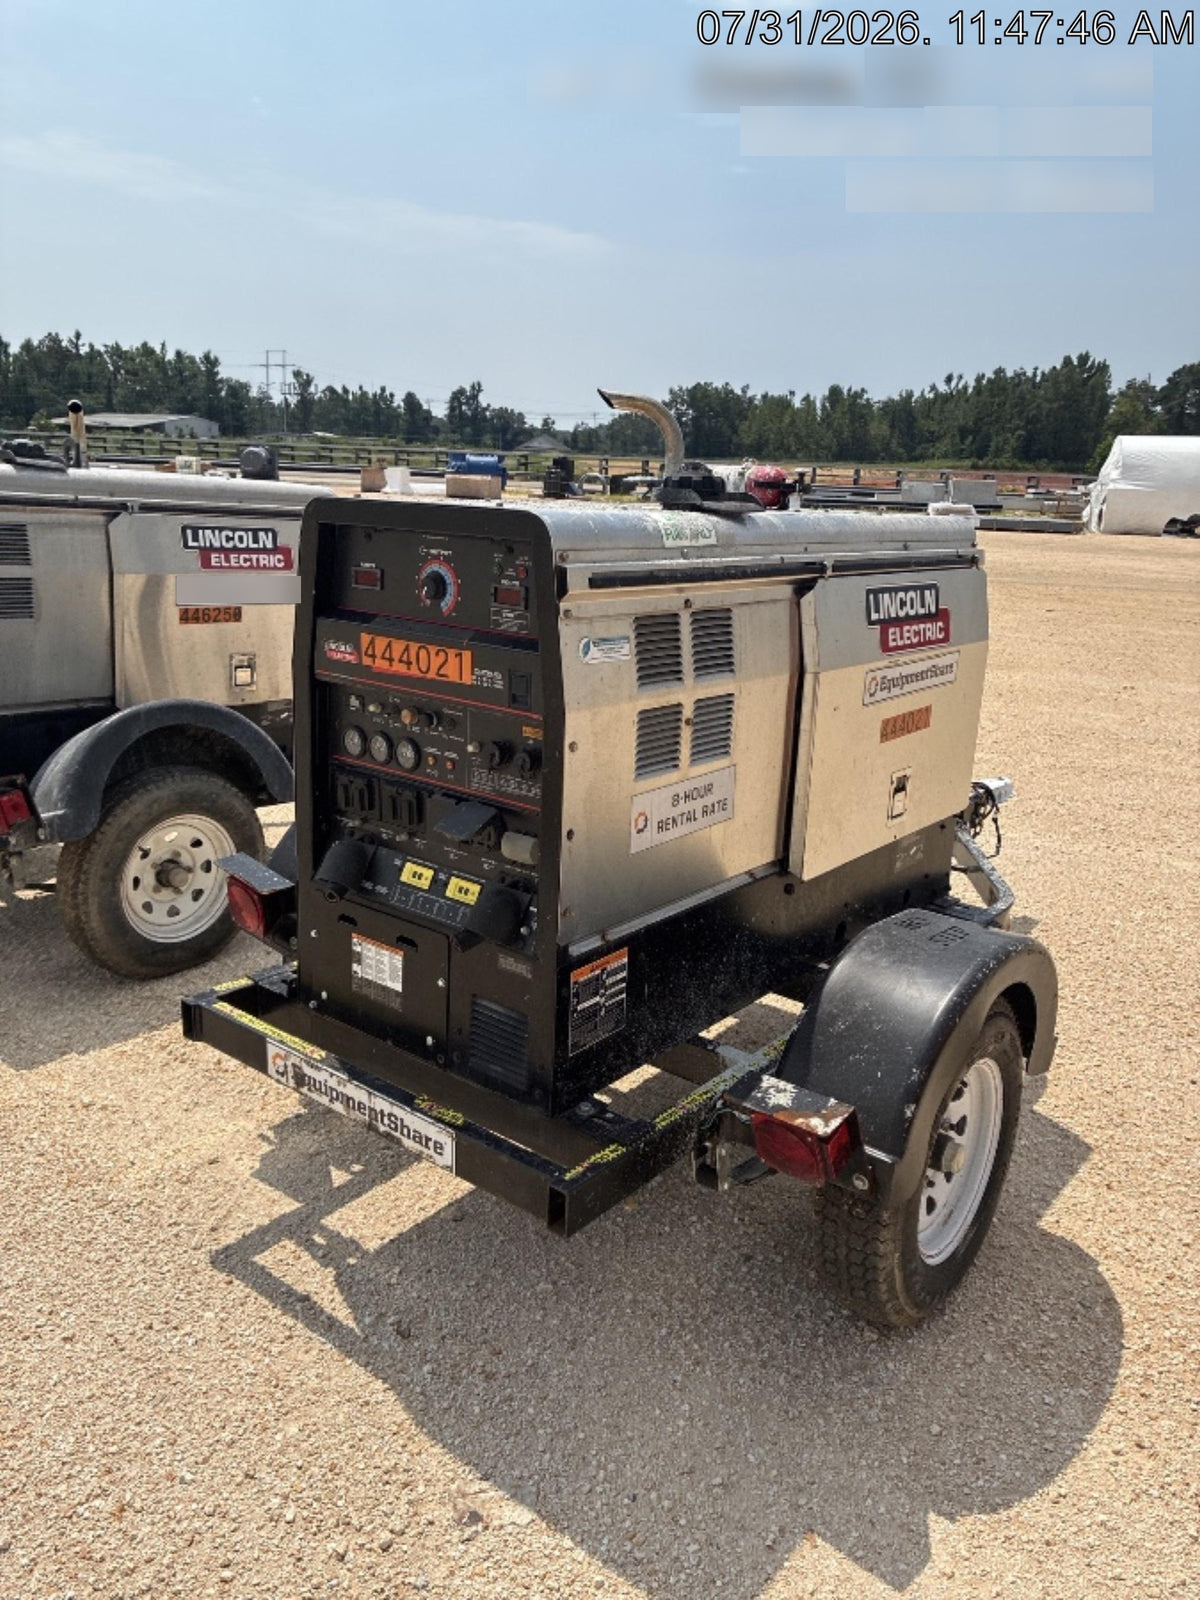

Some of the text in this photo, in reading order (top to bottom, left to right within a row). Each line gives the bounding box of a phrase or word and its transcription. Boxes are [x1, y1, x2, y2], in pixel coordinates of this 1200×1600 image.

[186, 529, 274, 549] LINCOLN
[210, 553, 286, 568] ELECTRIC
[868, 588, 937, 621] LINCOLN
[887, 621, 945, 648] ELECTRIC
[363, 636, 464, 682] 444021
[671, 782, 715, 809] 8-HOUR
[656, 797, 729, 835] RENTAL RATE
[291, 1063, 444, 1157] EquipmentShare
